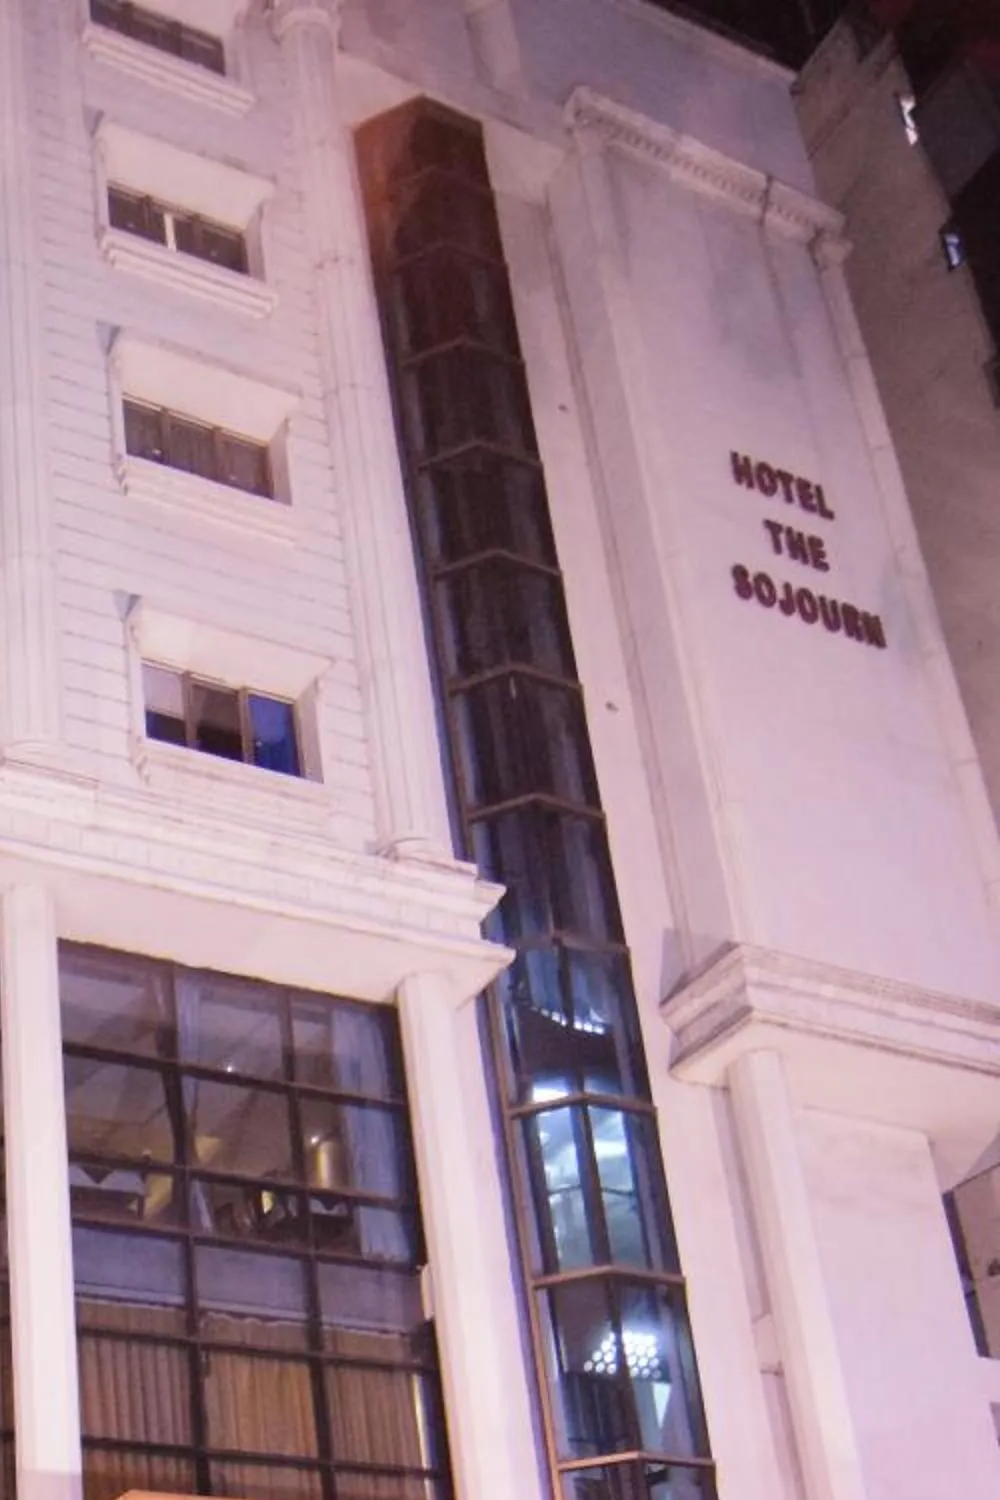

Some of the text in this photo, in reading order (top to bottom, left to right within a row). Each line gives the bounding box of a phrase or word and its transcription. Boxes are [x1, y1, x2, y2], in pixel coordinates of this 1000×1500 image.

[730, 451, 835, 521] HOTEL
[763, 518, 830, 572] THE
[731, 563, 887, 649] SOJOURN
